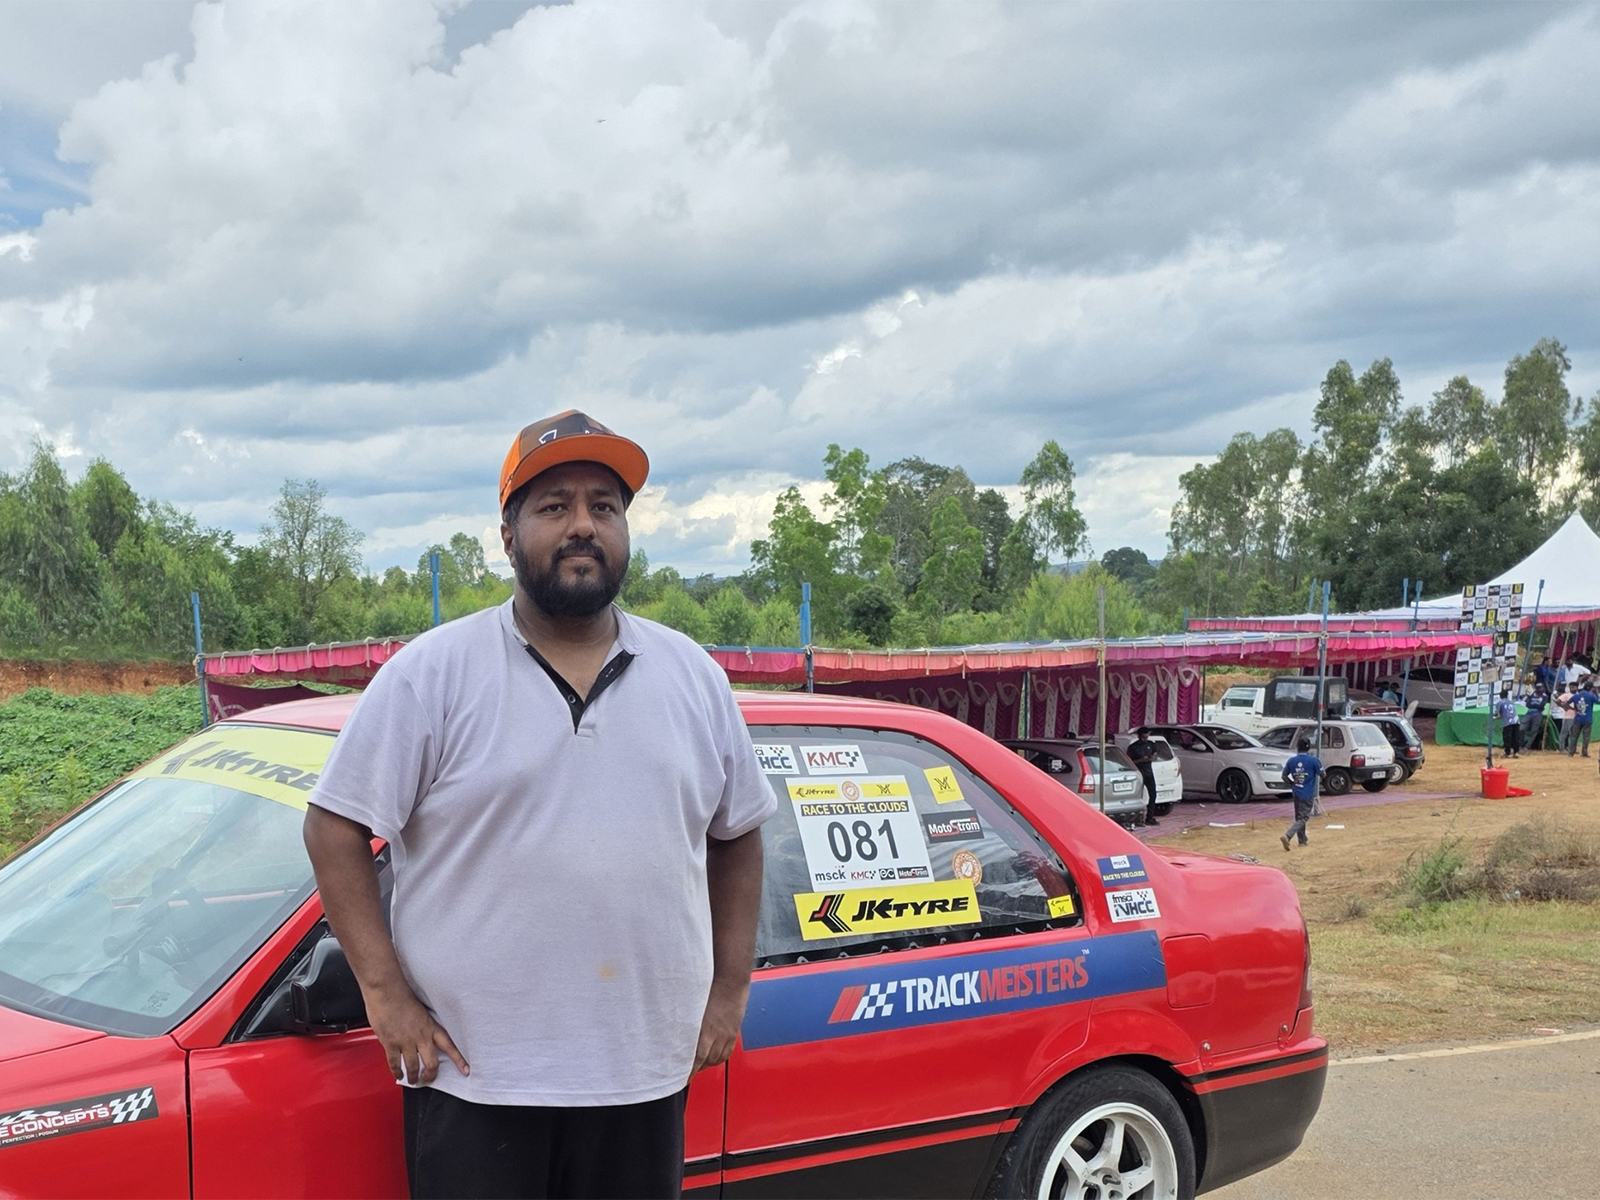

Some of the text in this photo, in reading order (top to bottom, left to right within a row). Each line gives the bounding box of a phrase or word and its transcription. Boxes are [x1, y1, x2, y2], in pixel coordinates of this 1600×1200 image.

[758, 756, 793, 769] HCC
[806, 751, 847, 767] KMC
[802, 801, 907, 816] RACE TO THE CLOUDS
[827, 819, 899, 863] 081
[900, 956, 1089, 1013] TRACKMEISTERS
[0, 1125, 9, 1137] E
[11, 1107, 110, 1135] CONCEPTS
[2, 1133, 35, 1144] PERFECTION
